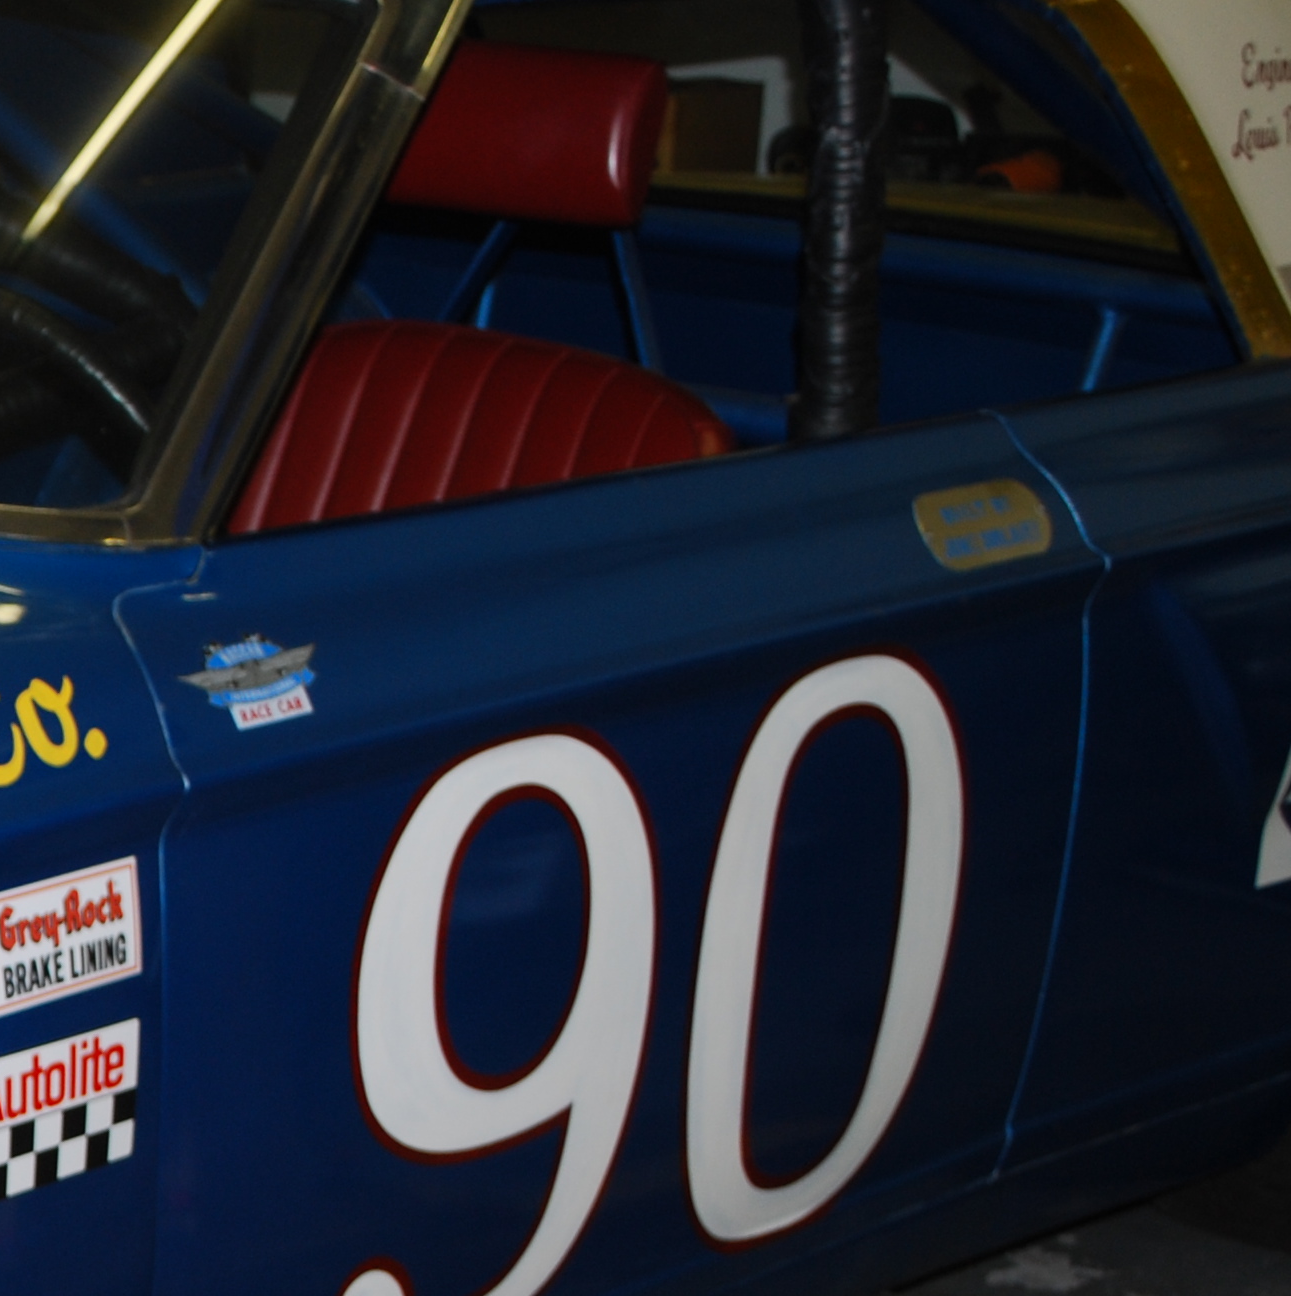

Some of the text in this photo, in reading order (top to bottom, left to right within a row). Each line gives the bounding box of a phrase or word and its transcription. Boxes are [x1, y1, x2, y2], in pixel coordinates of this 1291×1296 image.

[239, 696, 303, 723] RACE CAR
[2, 934, 128, 999] BRAKE LINING
